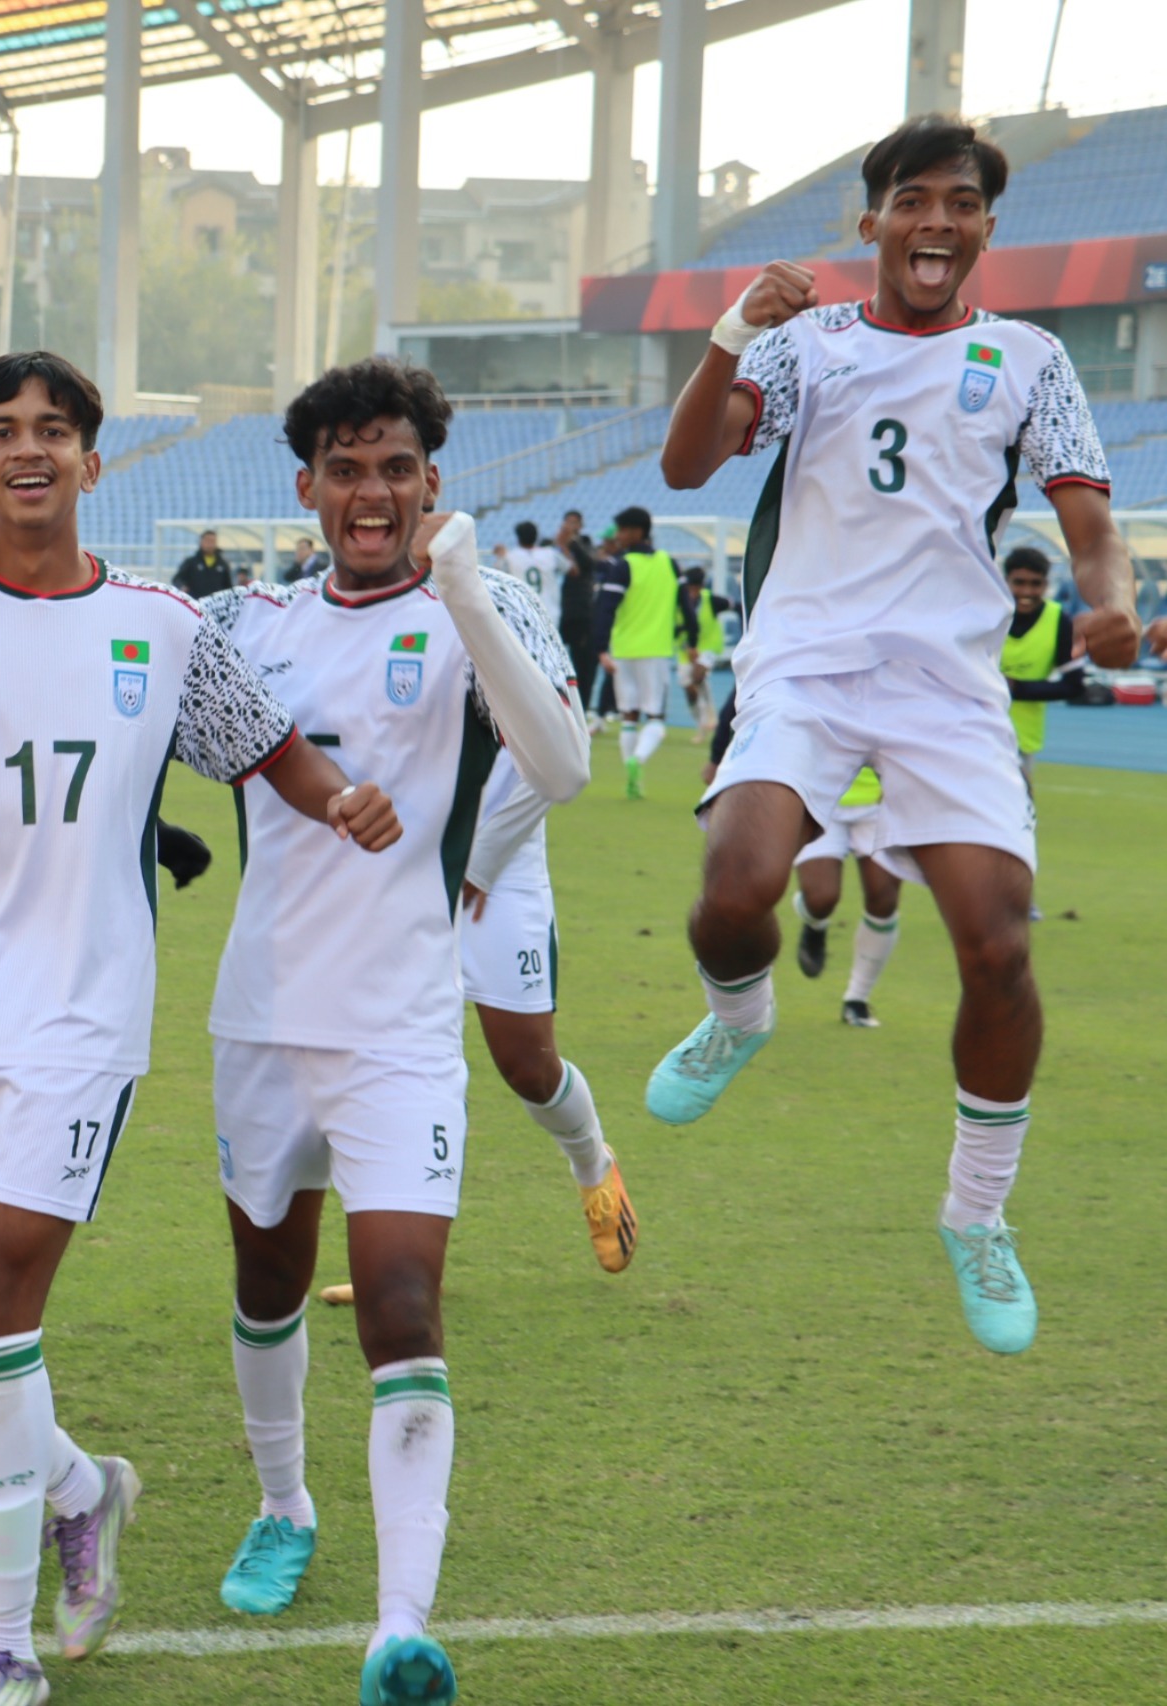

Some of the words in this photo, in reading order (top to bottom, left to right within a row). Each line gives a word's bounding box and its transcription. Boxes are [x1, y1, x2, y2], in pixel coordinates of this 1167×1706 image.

[868, 418, 907, 493] 3
[525, 566, 542, 595] 9
[5, 739, 97, 826] 17
[517, 949, 542, 976] 20
[68, 1119, 101, 1160] 17
[432, 1124, 448, 1162] 5
